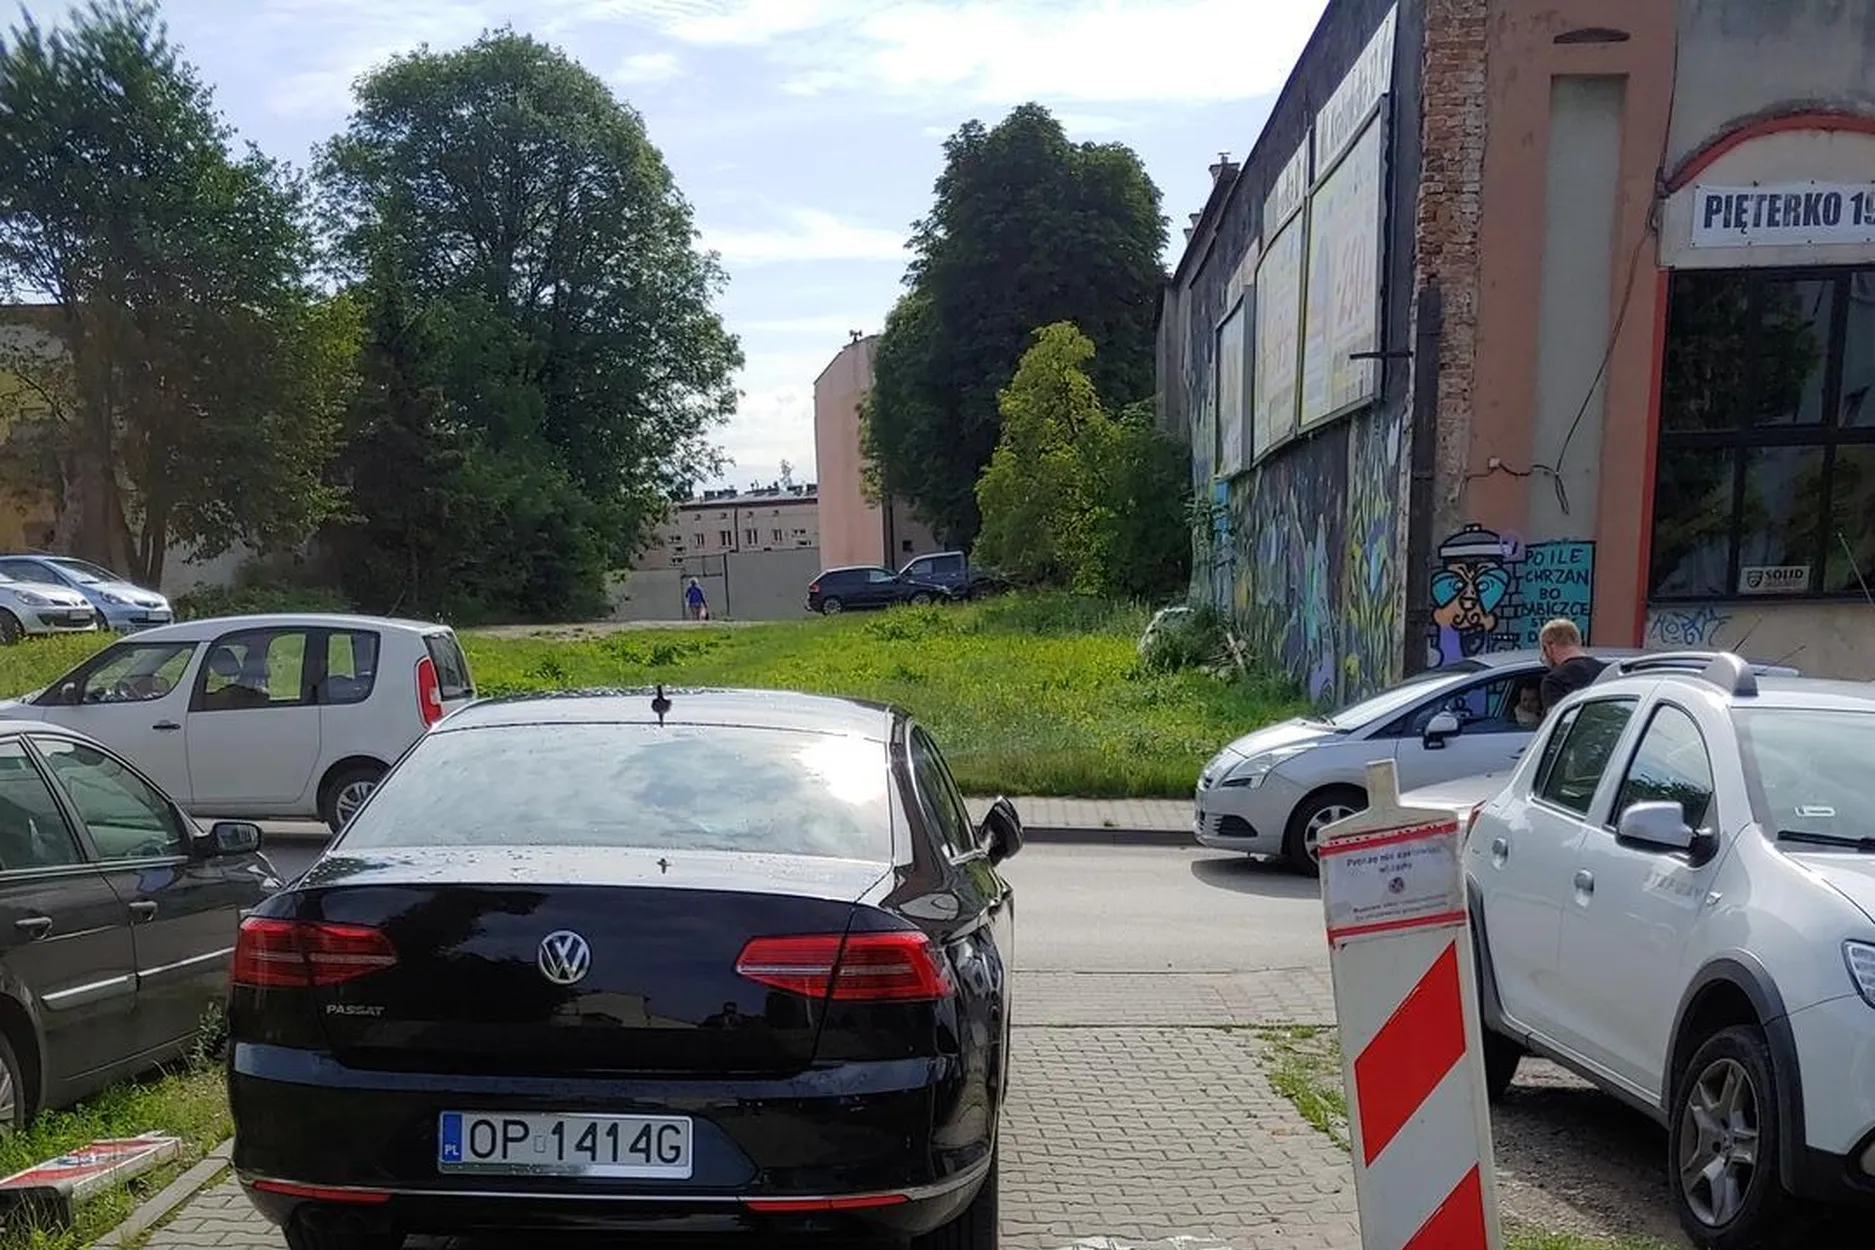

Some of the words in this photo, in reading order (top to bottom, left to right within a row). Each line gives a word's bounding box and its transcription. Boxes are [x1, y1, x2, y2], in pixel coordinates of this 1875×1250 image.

[1703, 191, 1842, 235] PIĘTERKO
[1524, 550, 1545, 567] PO
[1549, 547, 1584, 565] ILE
[1525, 568, 1590, 587] CHRZAN
[1764, 568, 1804, 580] SOLID
[1539, 587, 1561, 601] BO
[325, 1003, 386, 1018] PASSAT
[443, 1143, 460, 1156] PL
[468, 1118, 531, 1160] OP
[550, 1120, 682, 1165] 1414G
